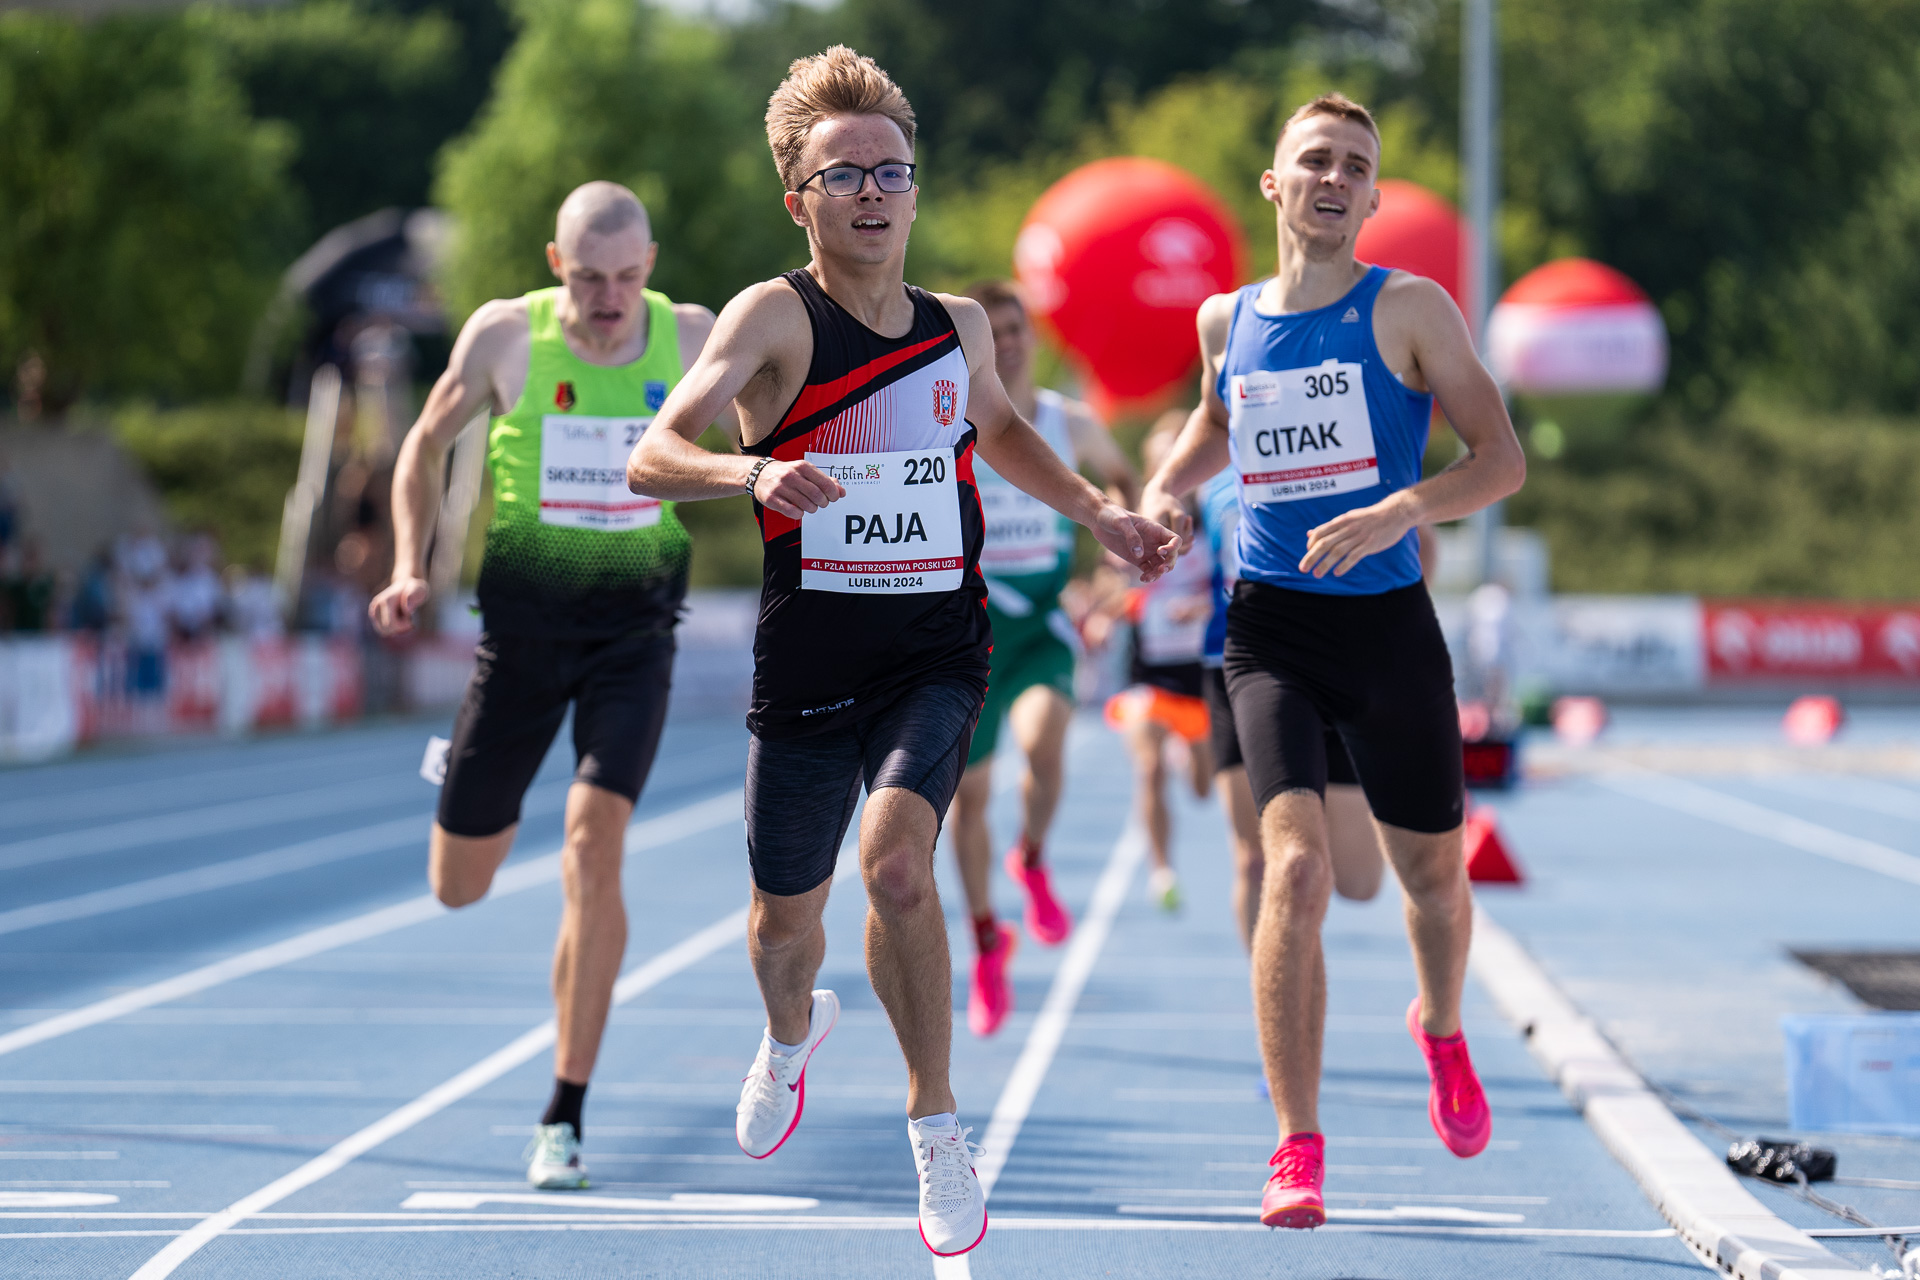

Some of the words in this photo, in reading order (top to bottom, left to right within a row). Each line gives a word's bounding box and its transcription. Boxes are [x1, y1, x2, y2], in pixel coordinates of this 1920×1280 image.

[1304, 371, 1349, 398] 305
[1255, 420, 1343, 456] CITAK
[903, 456, 946, 485] 220
[1271, 484, 1307, 497] LUBLIN
[1308, 478, 1337, 491] 2024
[844, 512, 928, 545] PAJA
[811, 561, 823, 569] 41.
[824, 562, 845, 571] PZLA
[847, 562, 911, 572] MISTRZOSTWA
[912, 561, 941, 570] POLSKI
[942, 559, 957, 568] U23
[848, 577, 891, 588] LUBLIN
[893, 577, 924, 587] 2024
